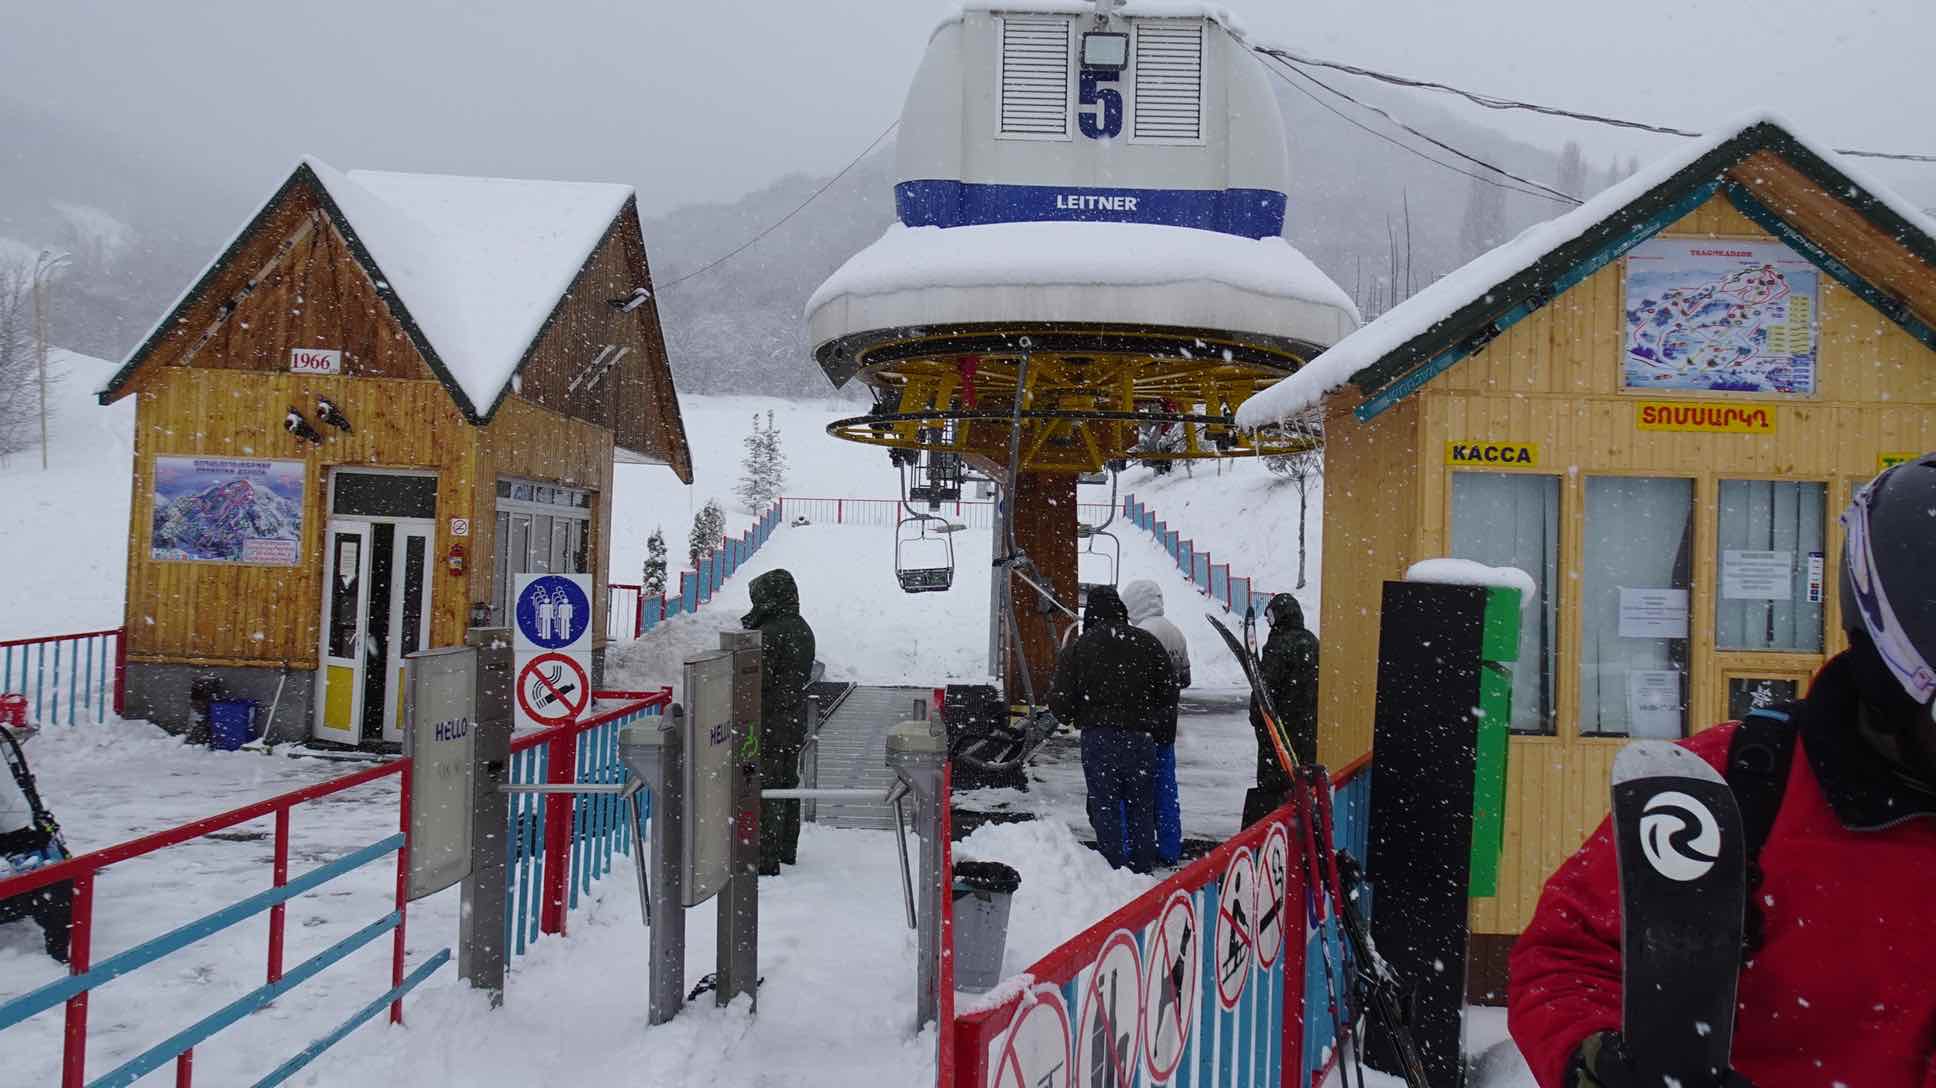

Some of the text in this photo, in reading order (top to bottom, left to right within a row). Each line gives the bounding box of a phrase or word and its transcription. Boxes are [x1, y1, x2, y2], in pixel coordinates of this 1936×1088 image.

[1078, 70, 1123, 140] 5
[1056, 195, 1138, 212] LEITNER
[293, 352, 331, 370] 1966
[1642, 405, 1769, 428] ՏՈՄՍԱՐԿՂ
[1452, 445, 1532, 463] КАССА
[435, 716, 468, 742] HELLO
